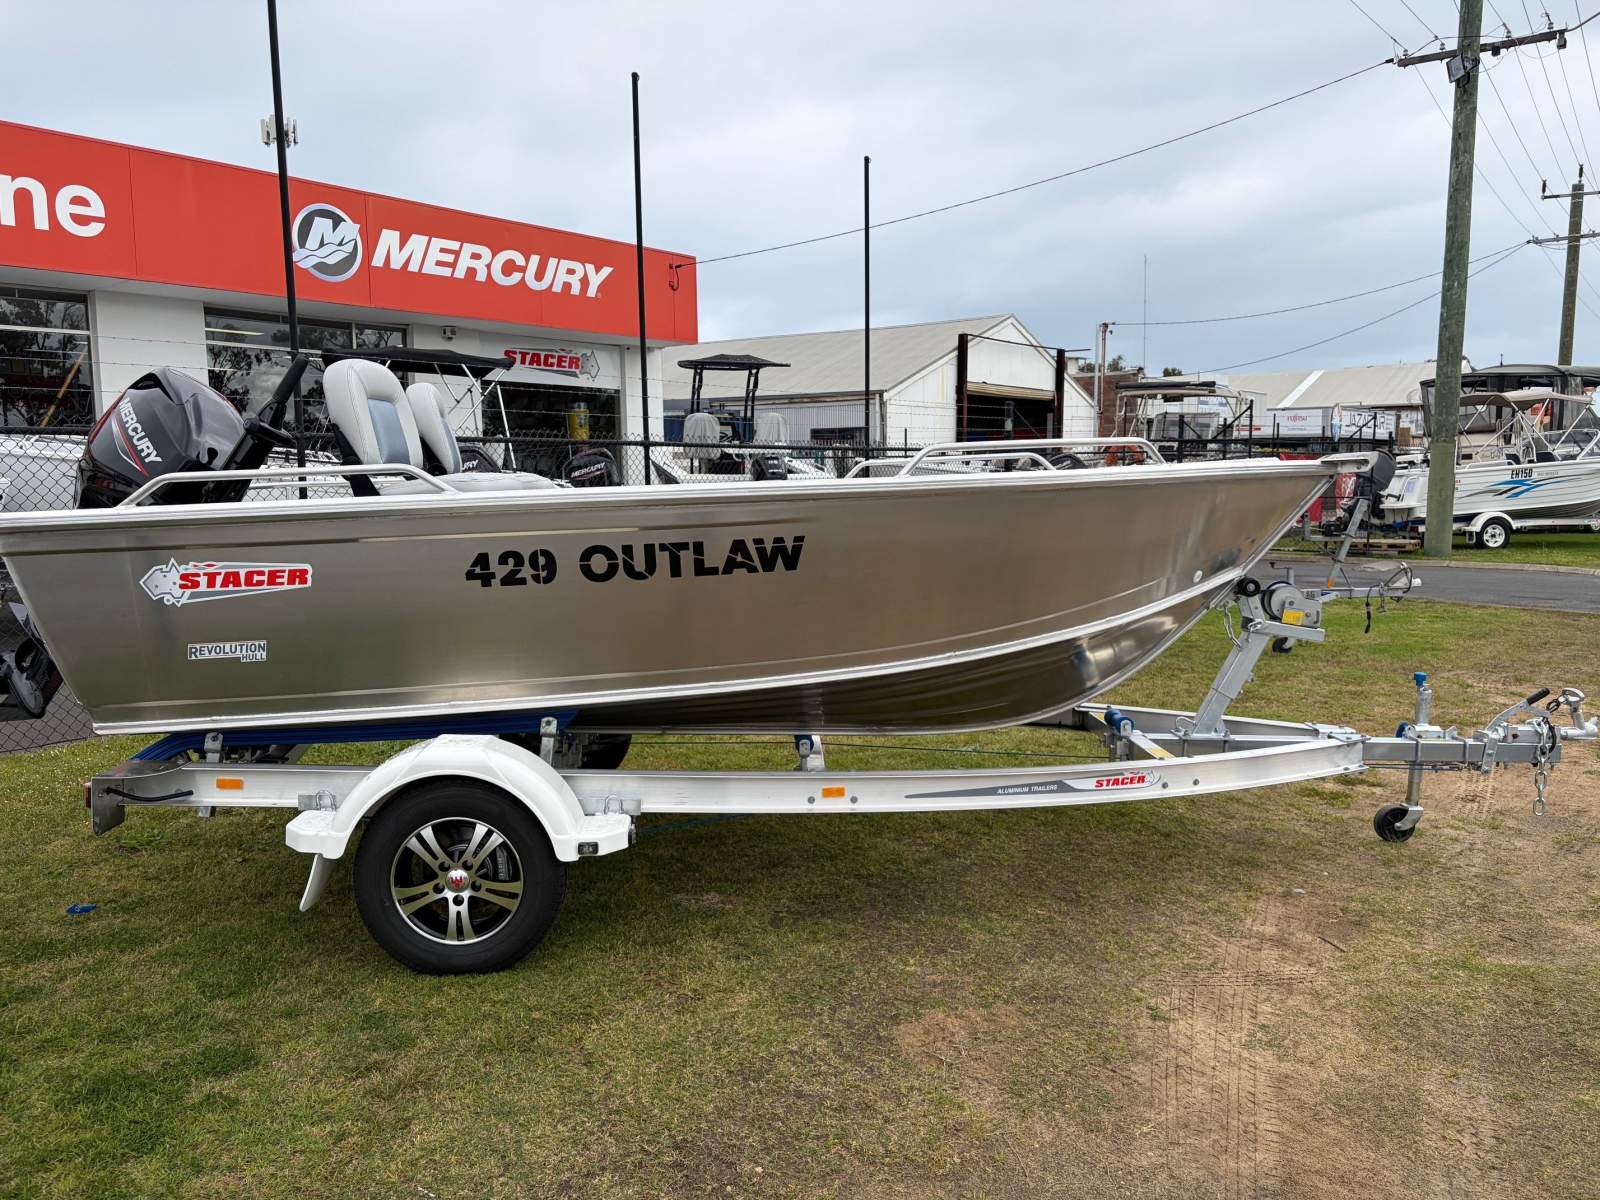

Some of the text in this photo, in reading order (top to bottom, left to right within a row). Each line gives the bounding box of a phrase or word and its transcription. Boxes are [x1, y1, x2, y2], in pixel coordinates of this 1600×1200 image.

[0, 173, 106, 237] ne
[371, 228, 614, 298] MERCURY
[504, 349, 581, 370] STACER
[118, 397, 162, 463] MERCURY
[571, 462, 606, 478] MERCURY
[465, 536, 805, 587] 429 OUTLAW
[178, 568, 308, 590] STACER
[188, 642, 266, 659] REVOLUTION
[241, 653, 265, 661] HULL
[997, 784, 1058, 794] ALUMINIUM TRAILERS
[1094, 775, 1147, 788] STACER
